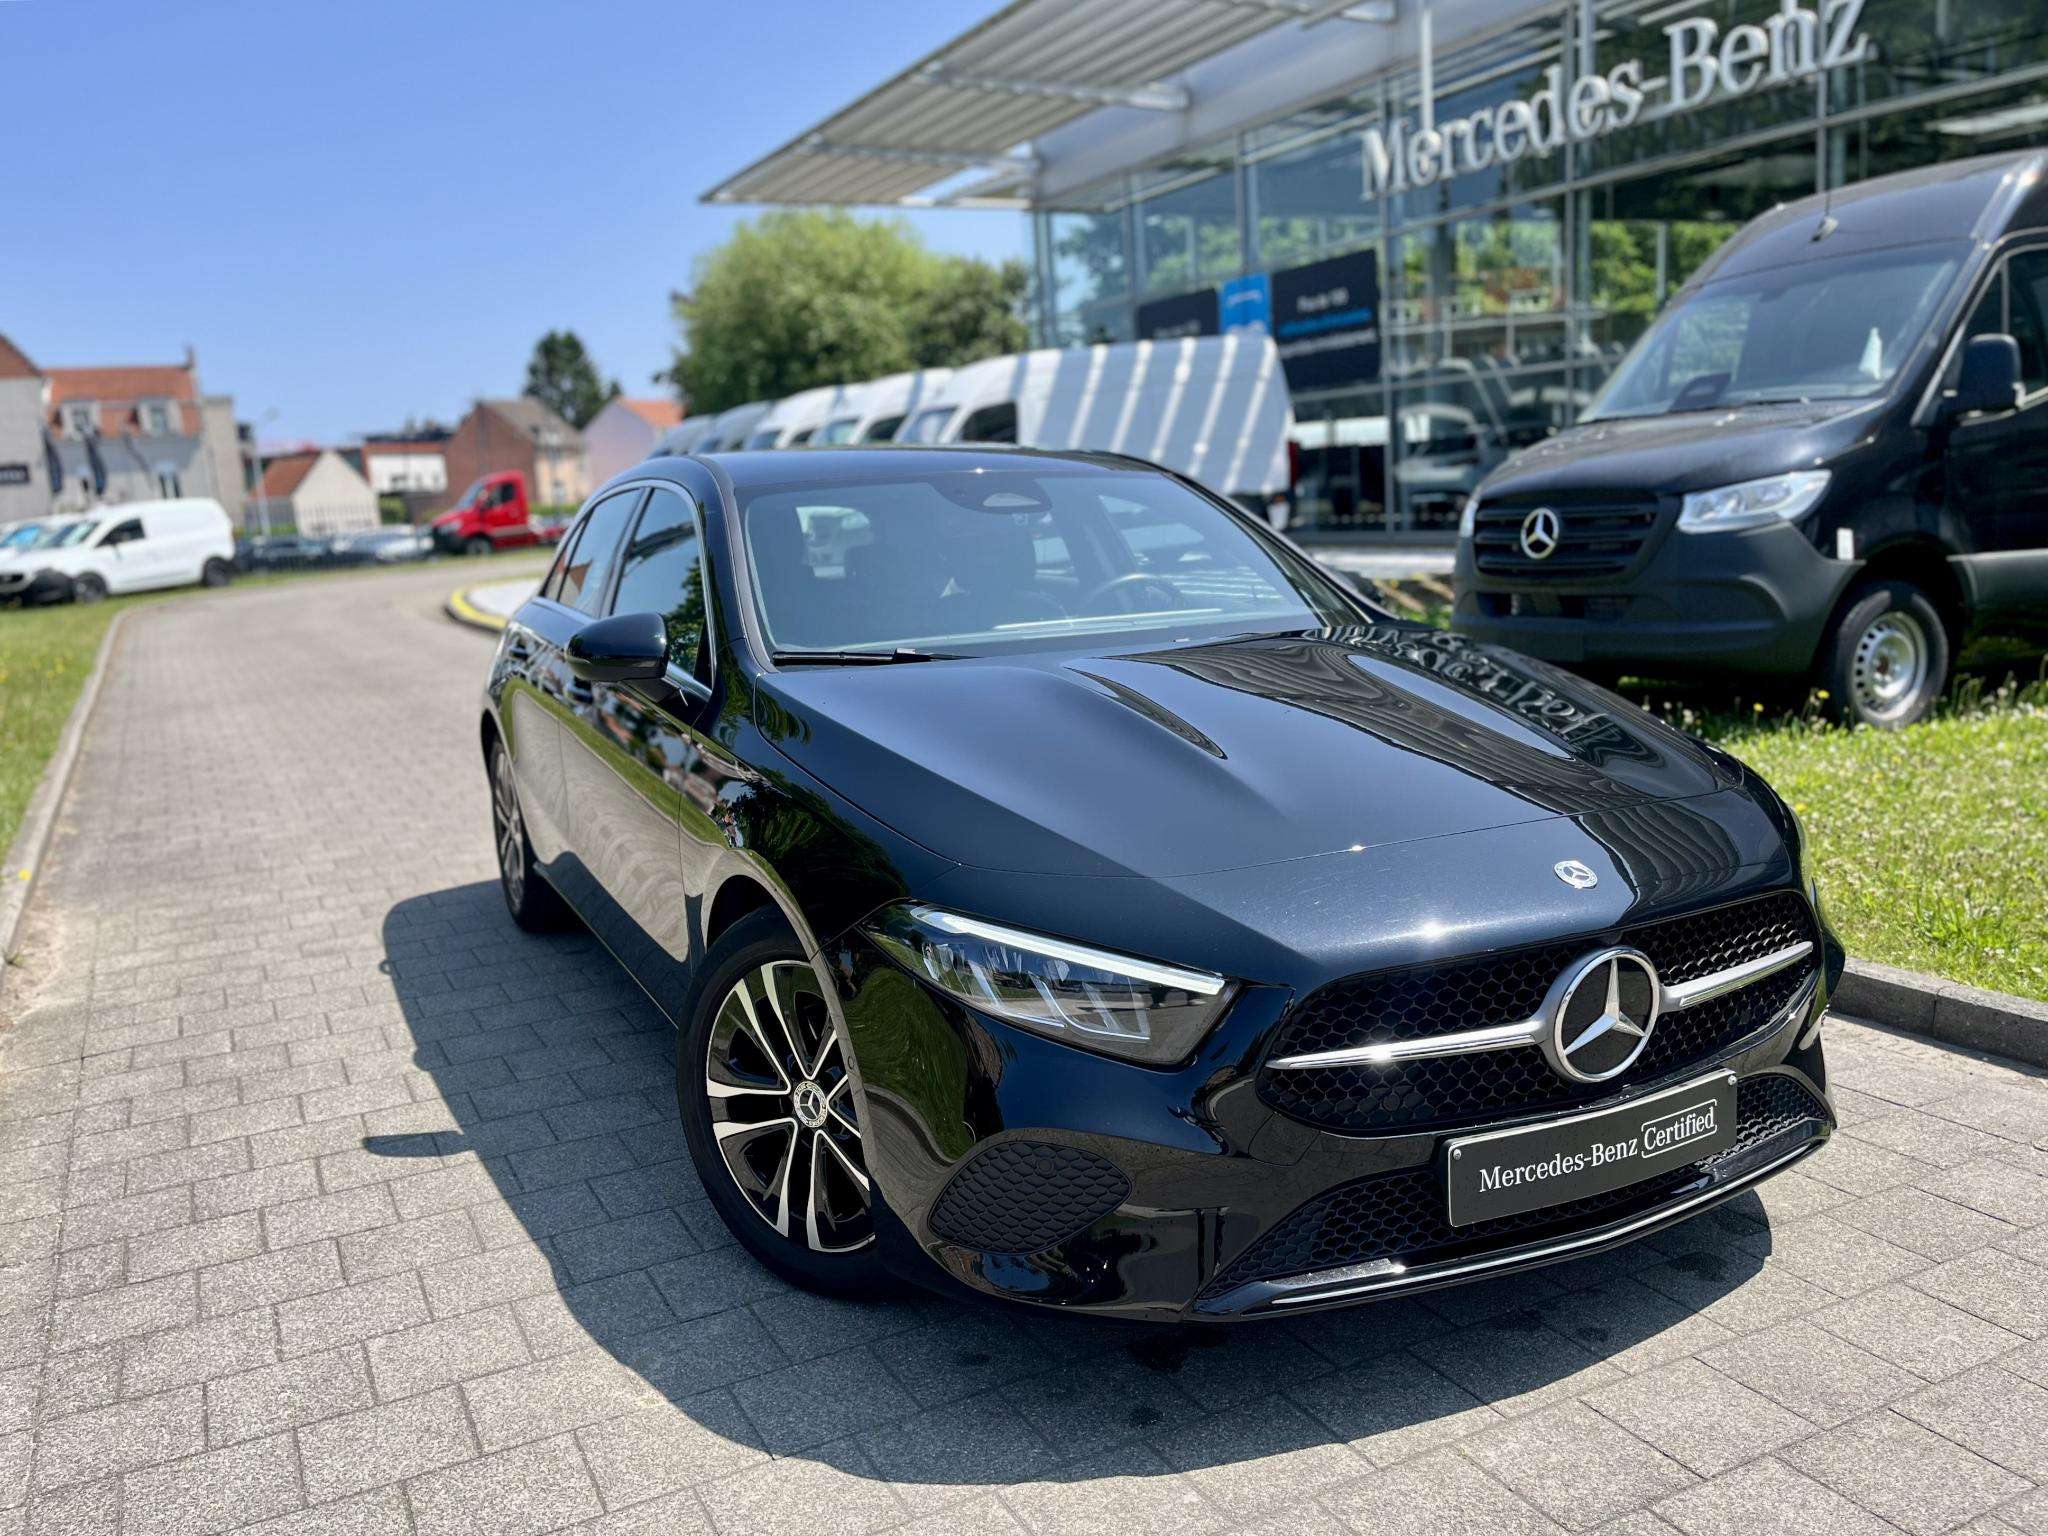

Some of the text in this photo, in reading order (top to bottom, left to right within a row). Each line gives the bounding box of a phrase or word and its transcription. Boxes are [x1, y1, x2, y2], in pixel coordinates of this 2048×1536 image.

[1360, 0, 1868, 200] Mercedes-Benz
[1478, 1106, 1715, 1193] Mercedes-Benz Certified
